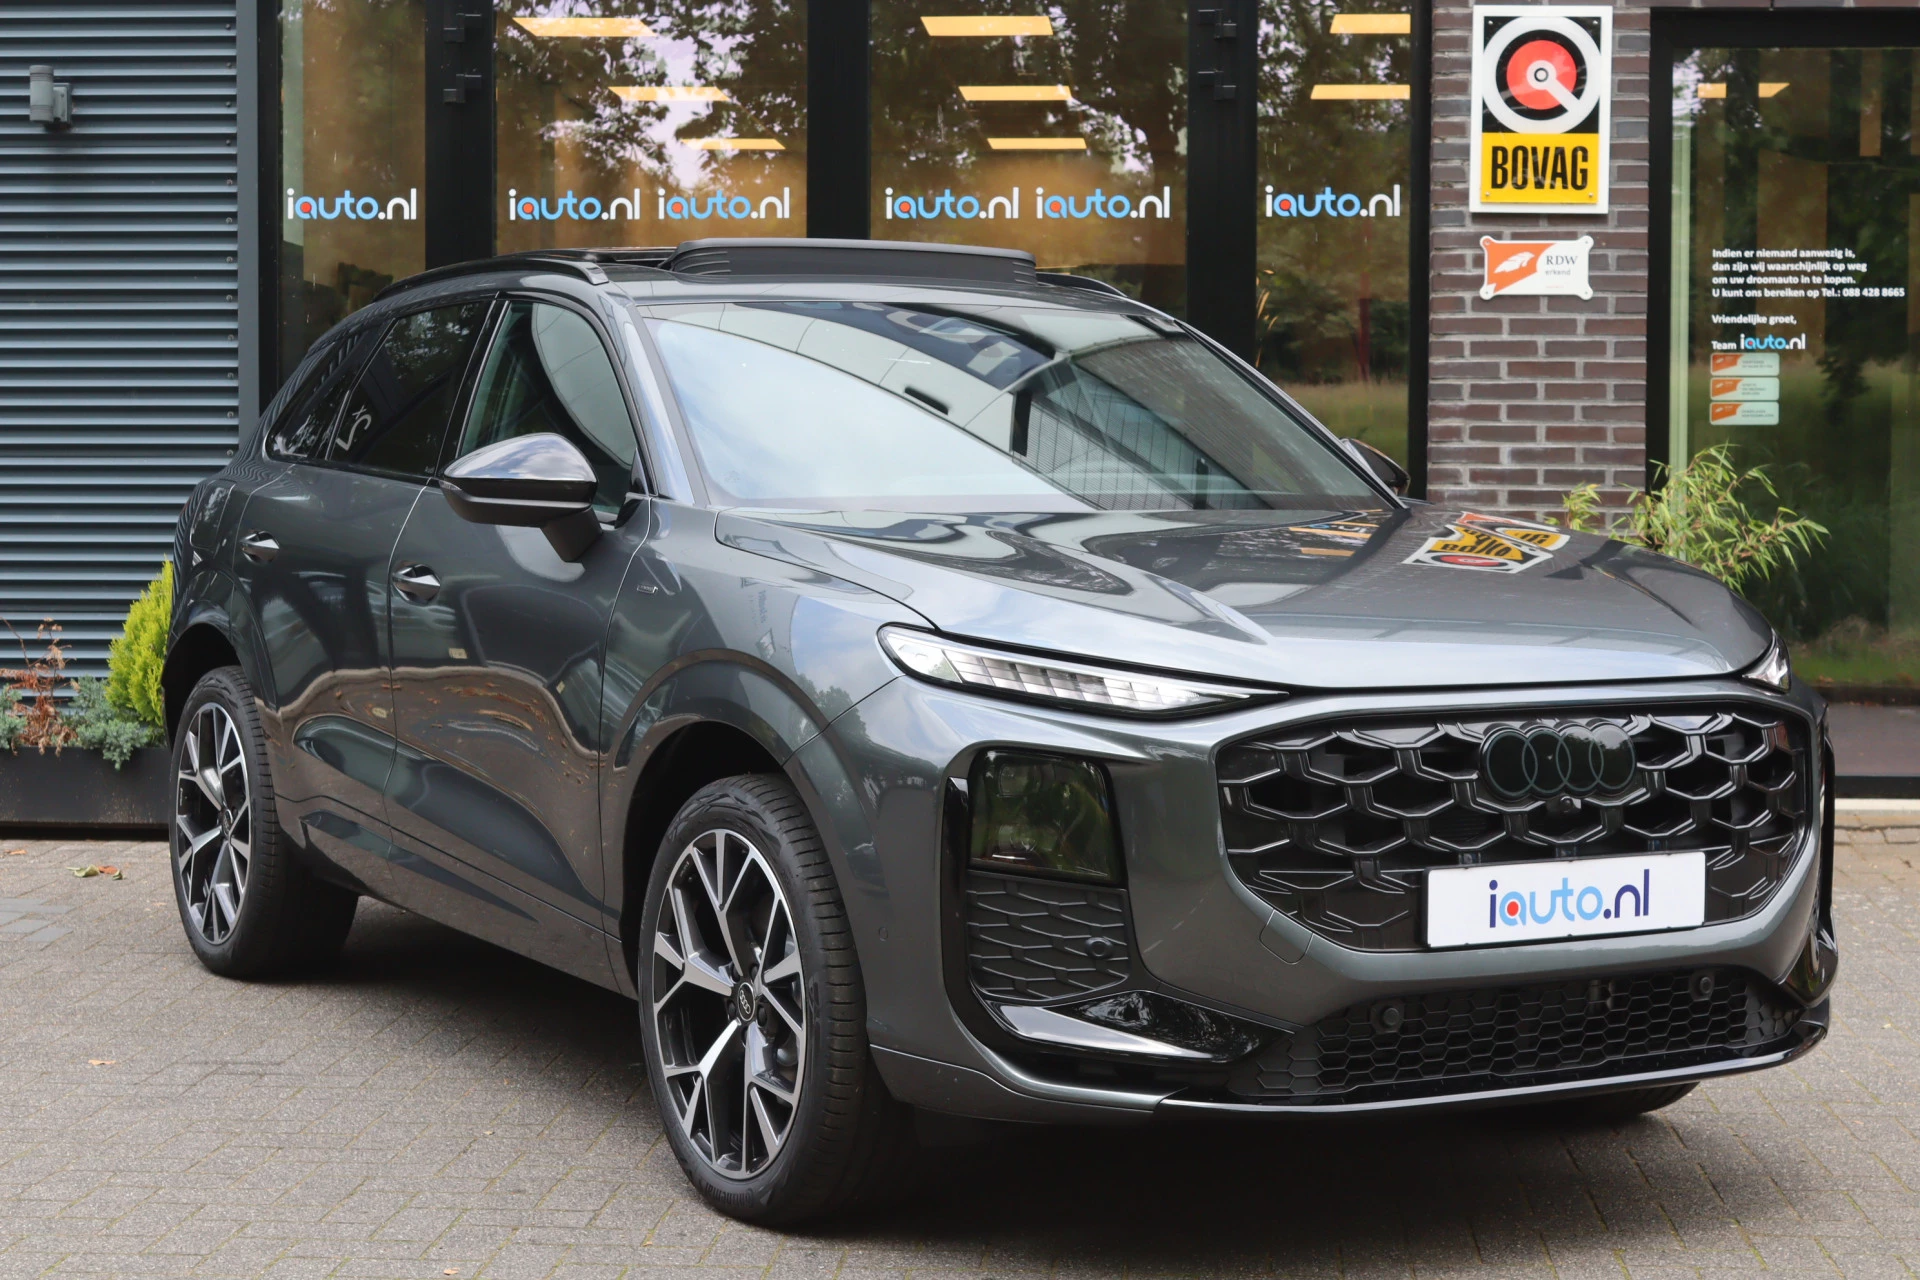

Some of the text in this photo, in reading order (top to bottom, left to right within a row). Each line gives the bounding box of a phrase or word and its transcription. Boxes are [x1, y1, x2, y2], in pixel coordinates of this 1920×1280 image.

[1491, 145, 1588, 191] BOVAG
[287, 188, 417, 220] iauto.nl
[509, 188, 640, 220] iauto.nl
[658, 187, 790, 220] iauto.nl
[886, 187, 1019, 220] iauto.nl
[1036, 186, 1170, 220] iauto.nl
[1265, 185, 1400, 218] iauto.nl
[1546, 255, 1578, 266] RDW
[1712, 249, 1856, 259] Indien er niemand aanwezig is,
[1545, 268, 1571, 276] erkend
[1712, 262, 1867, 273] dan zijn wij waarschijnlijk op weg
[1746, 275, 1799, 284] droomauto
[1801, 275, 1810, 284] in
[1812, 275, 1822, 284] te
[1824, 275, 1856, 285] kopen.
[1712, 288, 1720, 297] U
[1722, 288, 1743, 297] kunt
[1764, 288, 1804, 297] bereiken
[1806, 290, 1819, 298] op
[1821, 288, 1841, 297] Tel.:
[1842, 288, 1860, 297] 088
[1862, 288, 1880, 297] 428
[1881, 288, 1905, 297] 8665
[1711, 314, 1797, 325] Vriendelijke groet,
[1711, 333, 1806, 350] Team iauto.nl
[1489, 868, 1650, 928] iauto.nl
